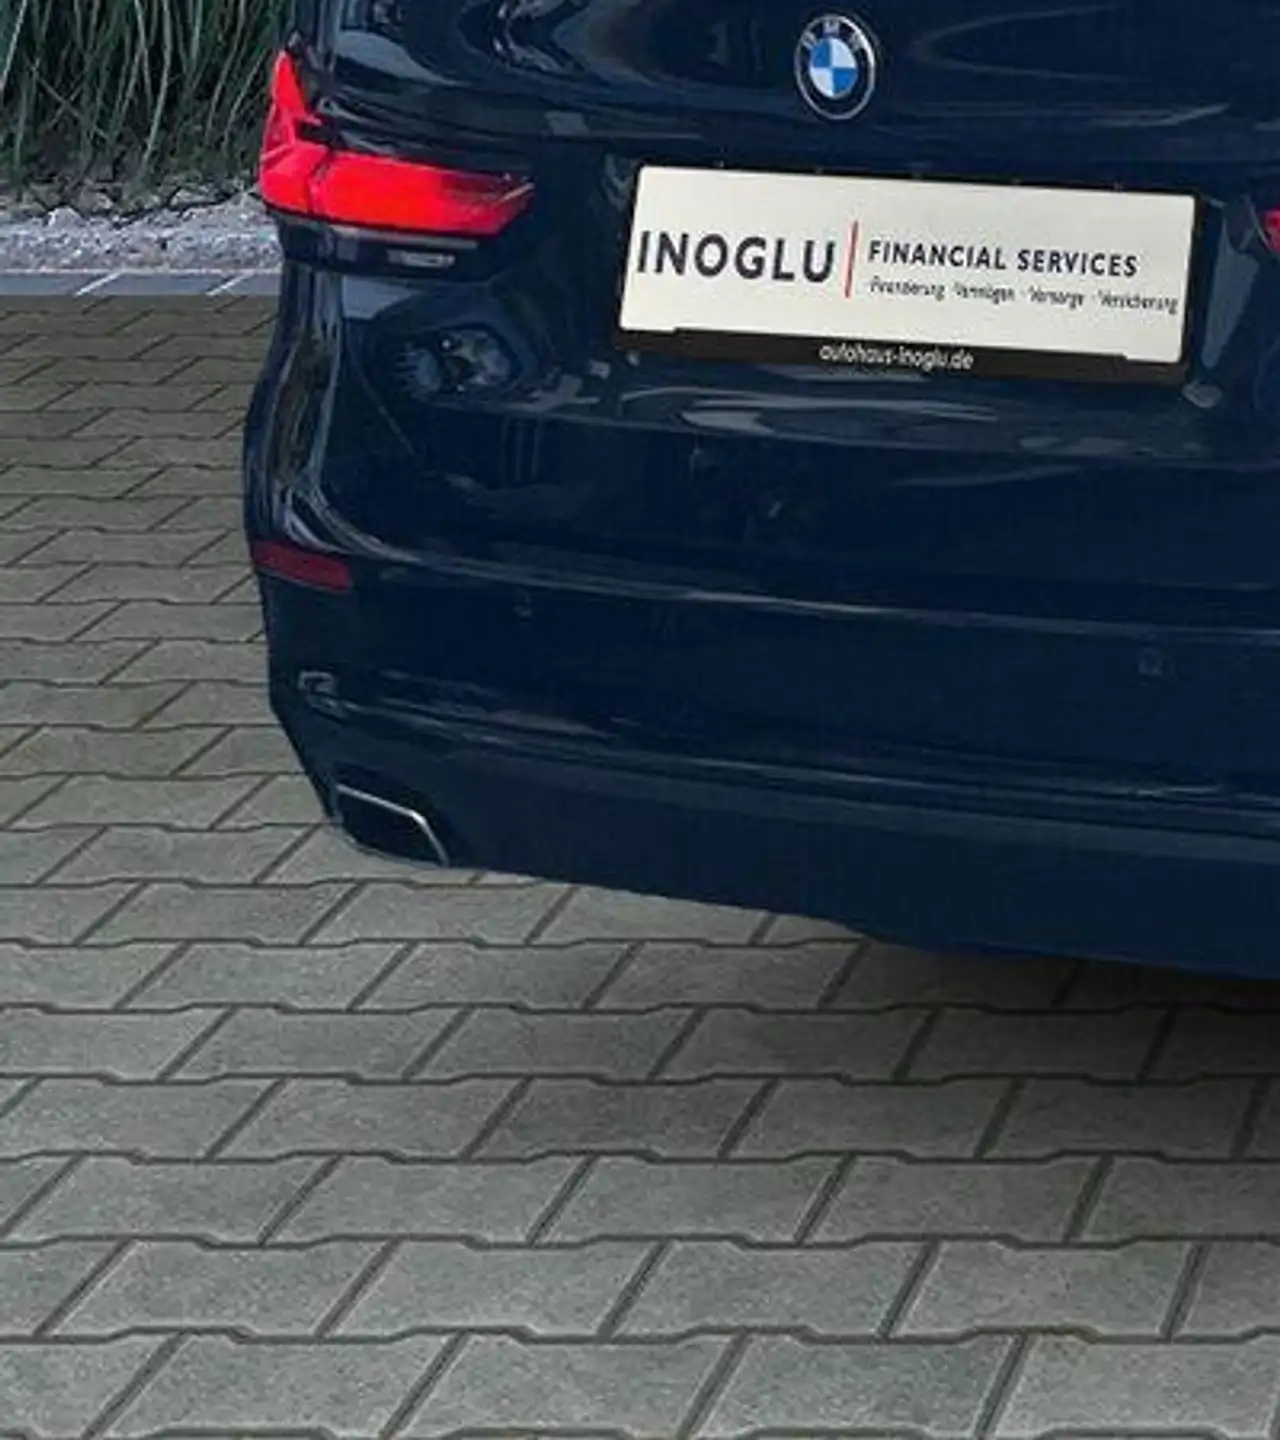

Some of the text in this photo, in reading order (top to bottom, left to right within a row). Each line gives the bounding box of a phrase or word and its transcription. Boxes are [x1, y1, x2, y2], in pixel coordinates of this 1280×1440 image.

[637, 230, 835, 283] INOGLU
[868, 240, 1138, 278] FINANCIAL SERVICES
[819, 342, 975, 372] autohaus-inoglu.de
